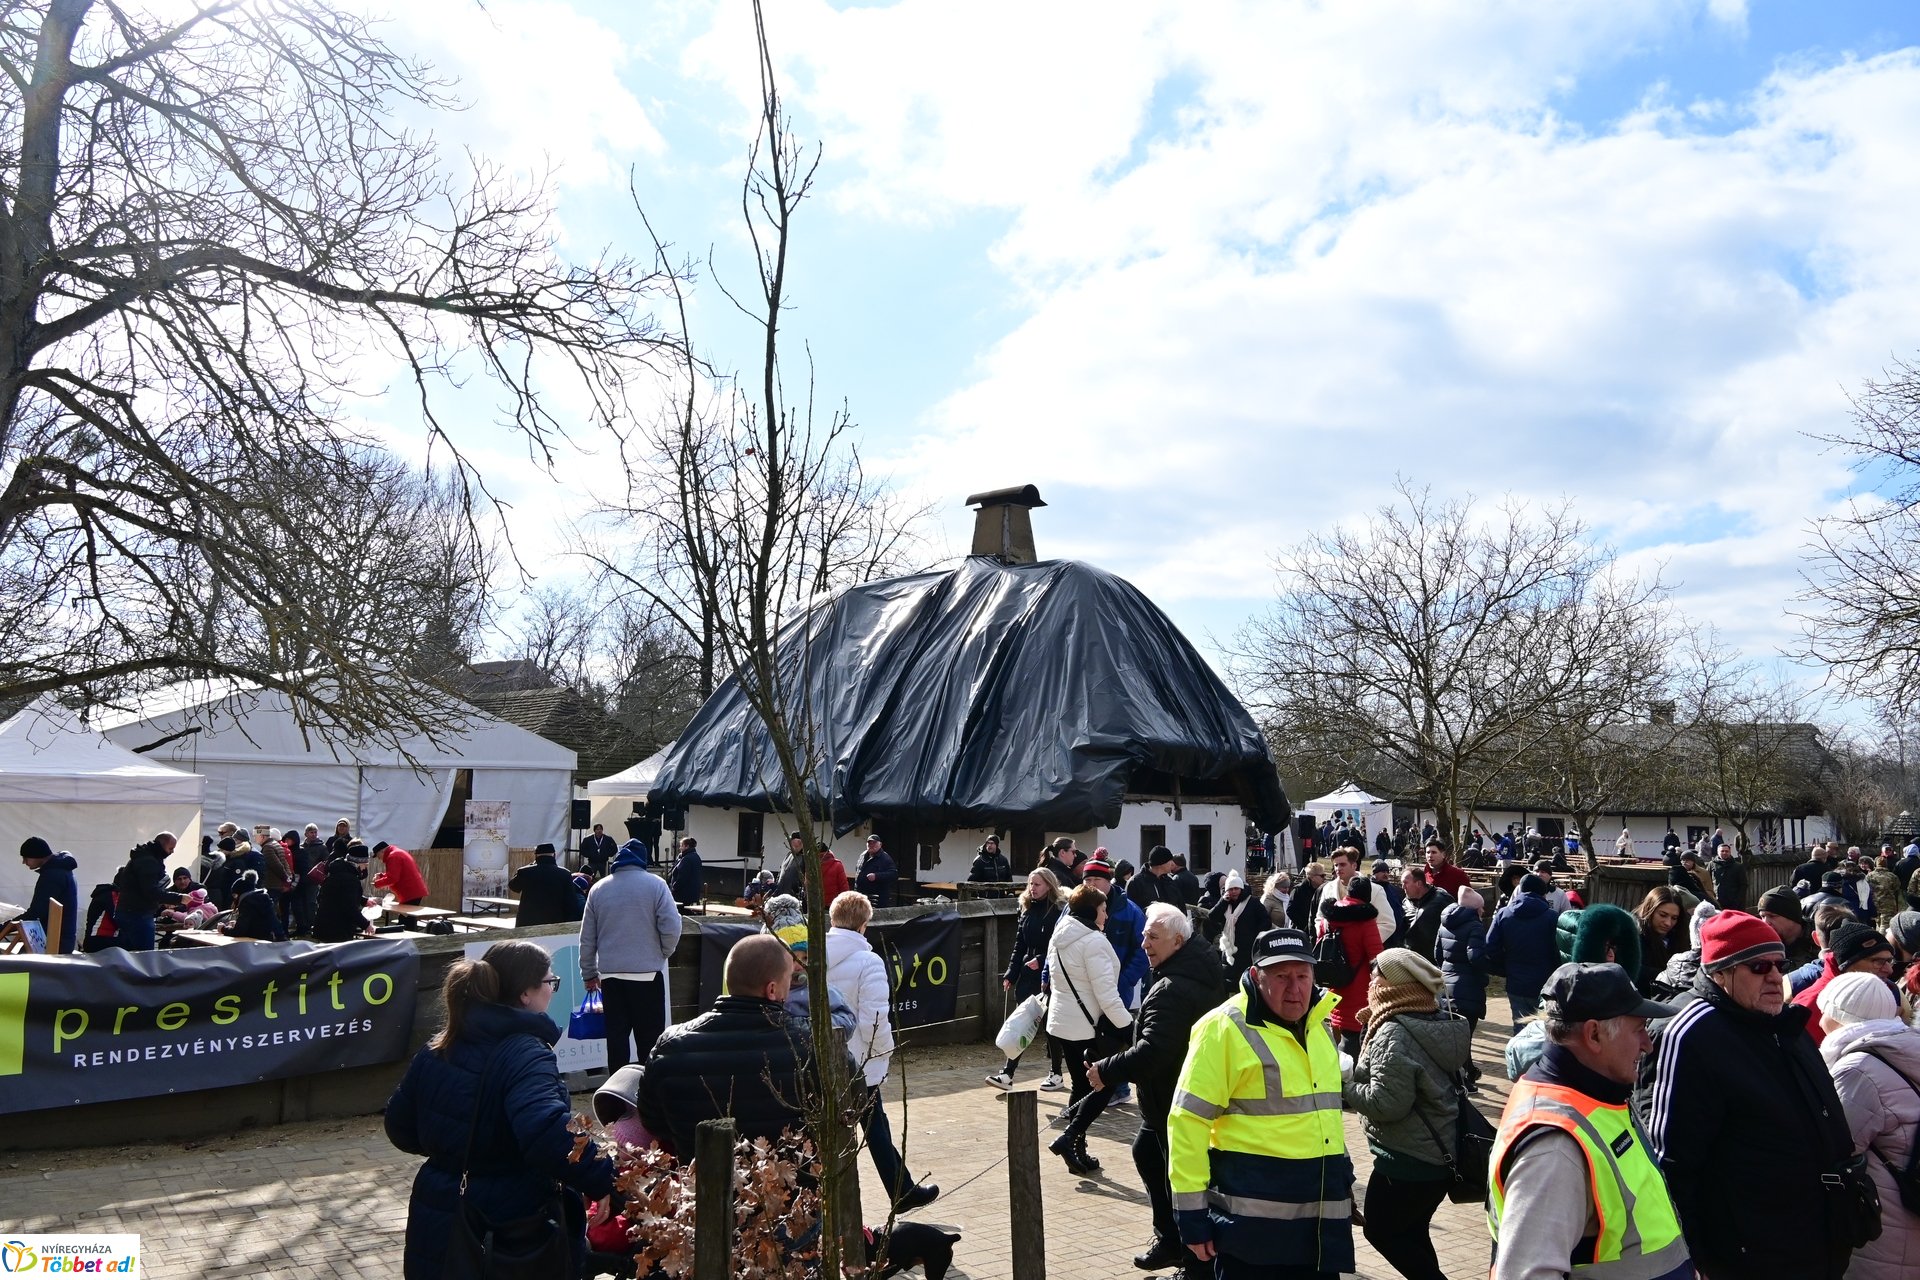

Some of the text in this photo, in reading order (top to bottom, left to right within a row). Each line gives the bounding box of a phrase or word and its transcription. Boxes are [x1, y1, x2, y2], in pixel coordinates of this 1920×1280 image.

[53, 971, 394, 1053] prestito
[74, 1018, 373, 1068] RENDEZVÉNYSZERVEZÉS
[558, 1043, 602, 1058] estit
